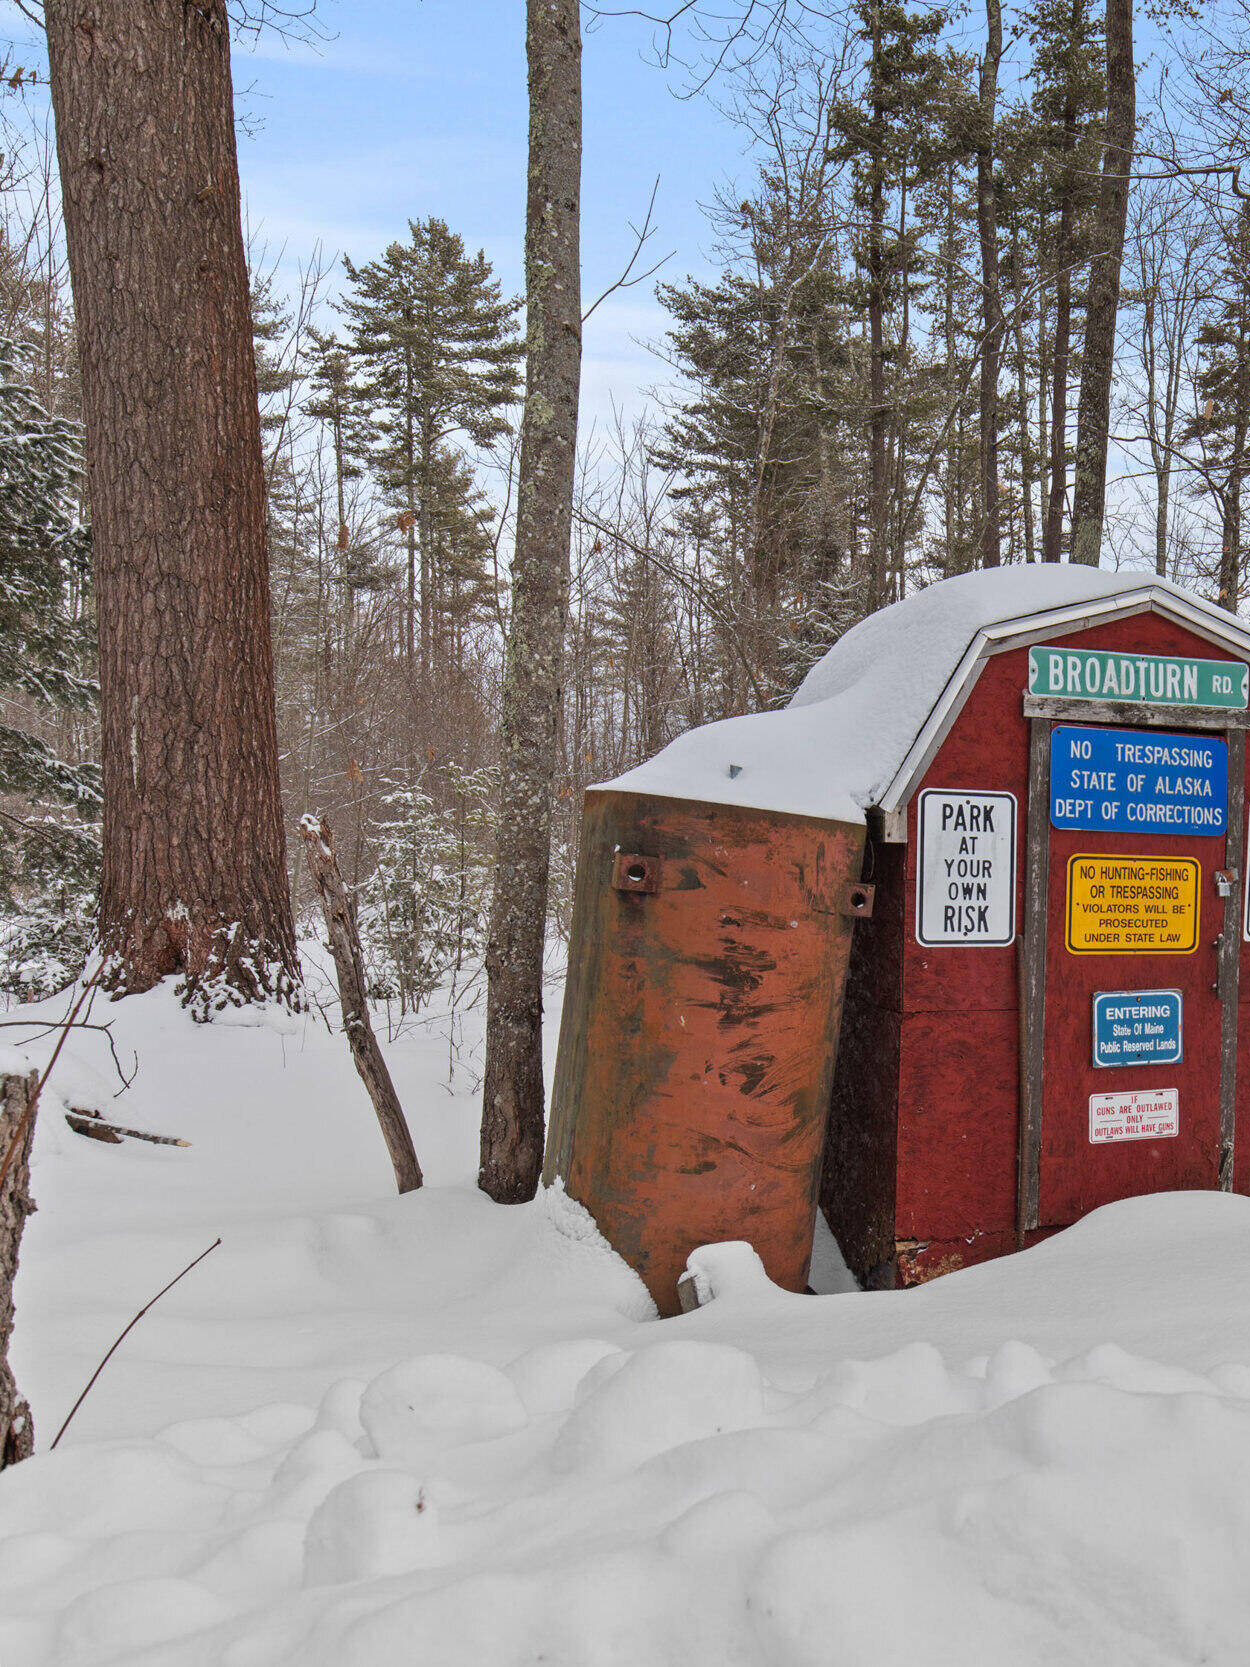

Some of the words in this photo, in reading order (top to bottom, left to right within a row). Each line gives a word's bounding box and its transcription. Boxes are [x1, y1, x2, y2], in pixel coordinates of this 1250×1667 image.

[1049, 654, 1198, 699] BROADTURN
[1212, 675, 1234, 695] RD.
[1070, 740, 1091, 759] NO
[1116, 743, 1213, 768] TRESPASSING
[1070, 770, 1116, 791] STATE
[1127, 774, 1146, 792] OF
[1155, 776, 1212, 797] ALASKA
[942, 803, 995, 832] PARK
[1055, 799, 1094, 818] DEPT
[1101, 802, 1121, 820] OF
[1127, 803, 1223, 826] CORRECTIONS
[959, 837, 978, 855] AT
[944, 859, 992, 878] YOUR
[1080, 866, 1095, 880] NO
[1101, 866, 1189, 881] HUNTING-FISHING
[948, 882, 987, 901] OWN
[1090, 885, 1105, 899] OR
[1110, 885, 1179, 900] TRESPASSING
[1082, 904, 1139, 914] VIOLATORS
[1144, 905, 1167, 914] WILL
[1172, 905, 1186, 914] BE
[944, 905, 989, 933] RISK
[1099, 919, 1168, 928] PROSECUTED
[1084, 933, 1120, 943] UNDER
[1125, 933, 1155, 942] STATE
[1160, 933, 1181, 942] LAW
[1106, 1005, 1170, 1020] ENTERING
[1113, 1024, 1131, 1036] State
[1134, 1023, 1142, 1035] Of
[1144, 1022, 1164, 1034] Maine
[1100, 1041, 1121, 1053] Public
[1123, 1039, 1154, 1052] Reserved
[1156, 1038, 1176, 1051] Lands
[1131, 1096, 1138, 1104] IF
[1096, 1106, 1115, 1116] GUNS
[1119, 1105, 1132, 1114] ARE
[1136, 1102, 1173, 1113] OUTLAWED
[1127, 1115, 1143, 1124] ONLY
[1095, 1126, 1123, 1137] OUTLAWS
[1125, 1125, 1139, 1134] WILL
[1141, 1123, 1156, 1133] HAVE
[1158, 1122, 1174, 1131] GUNS
